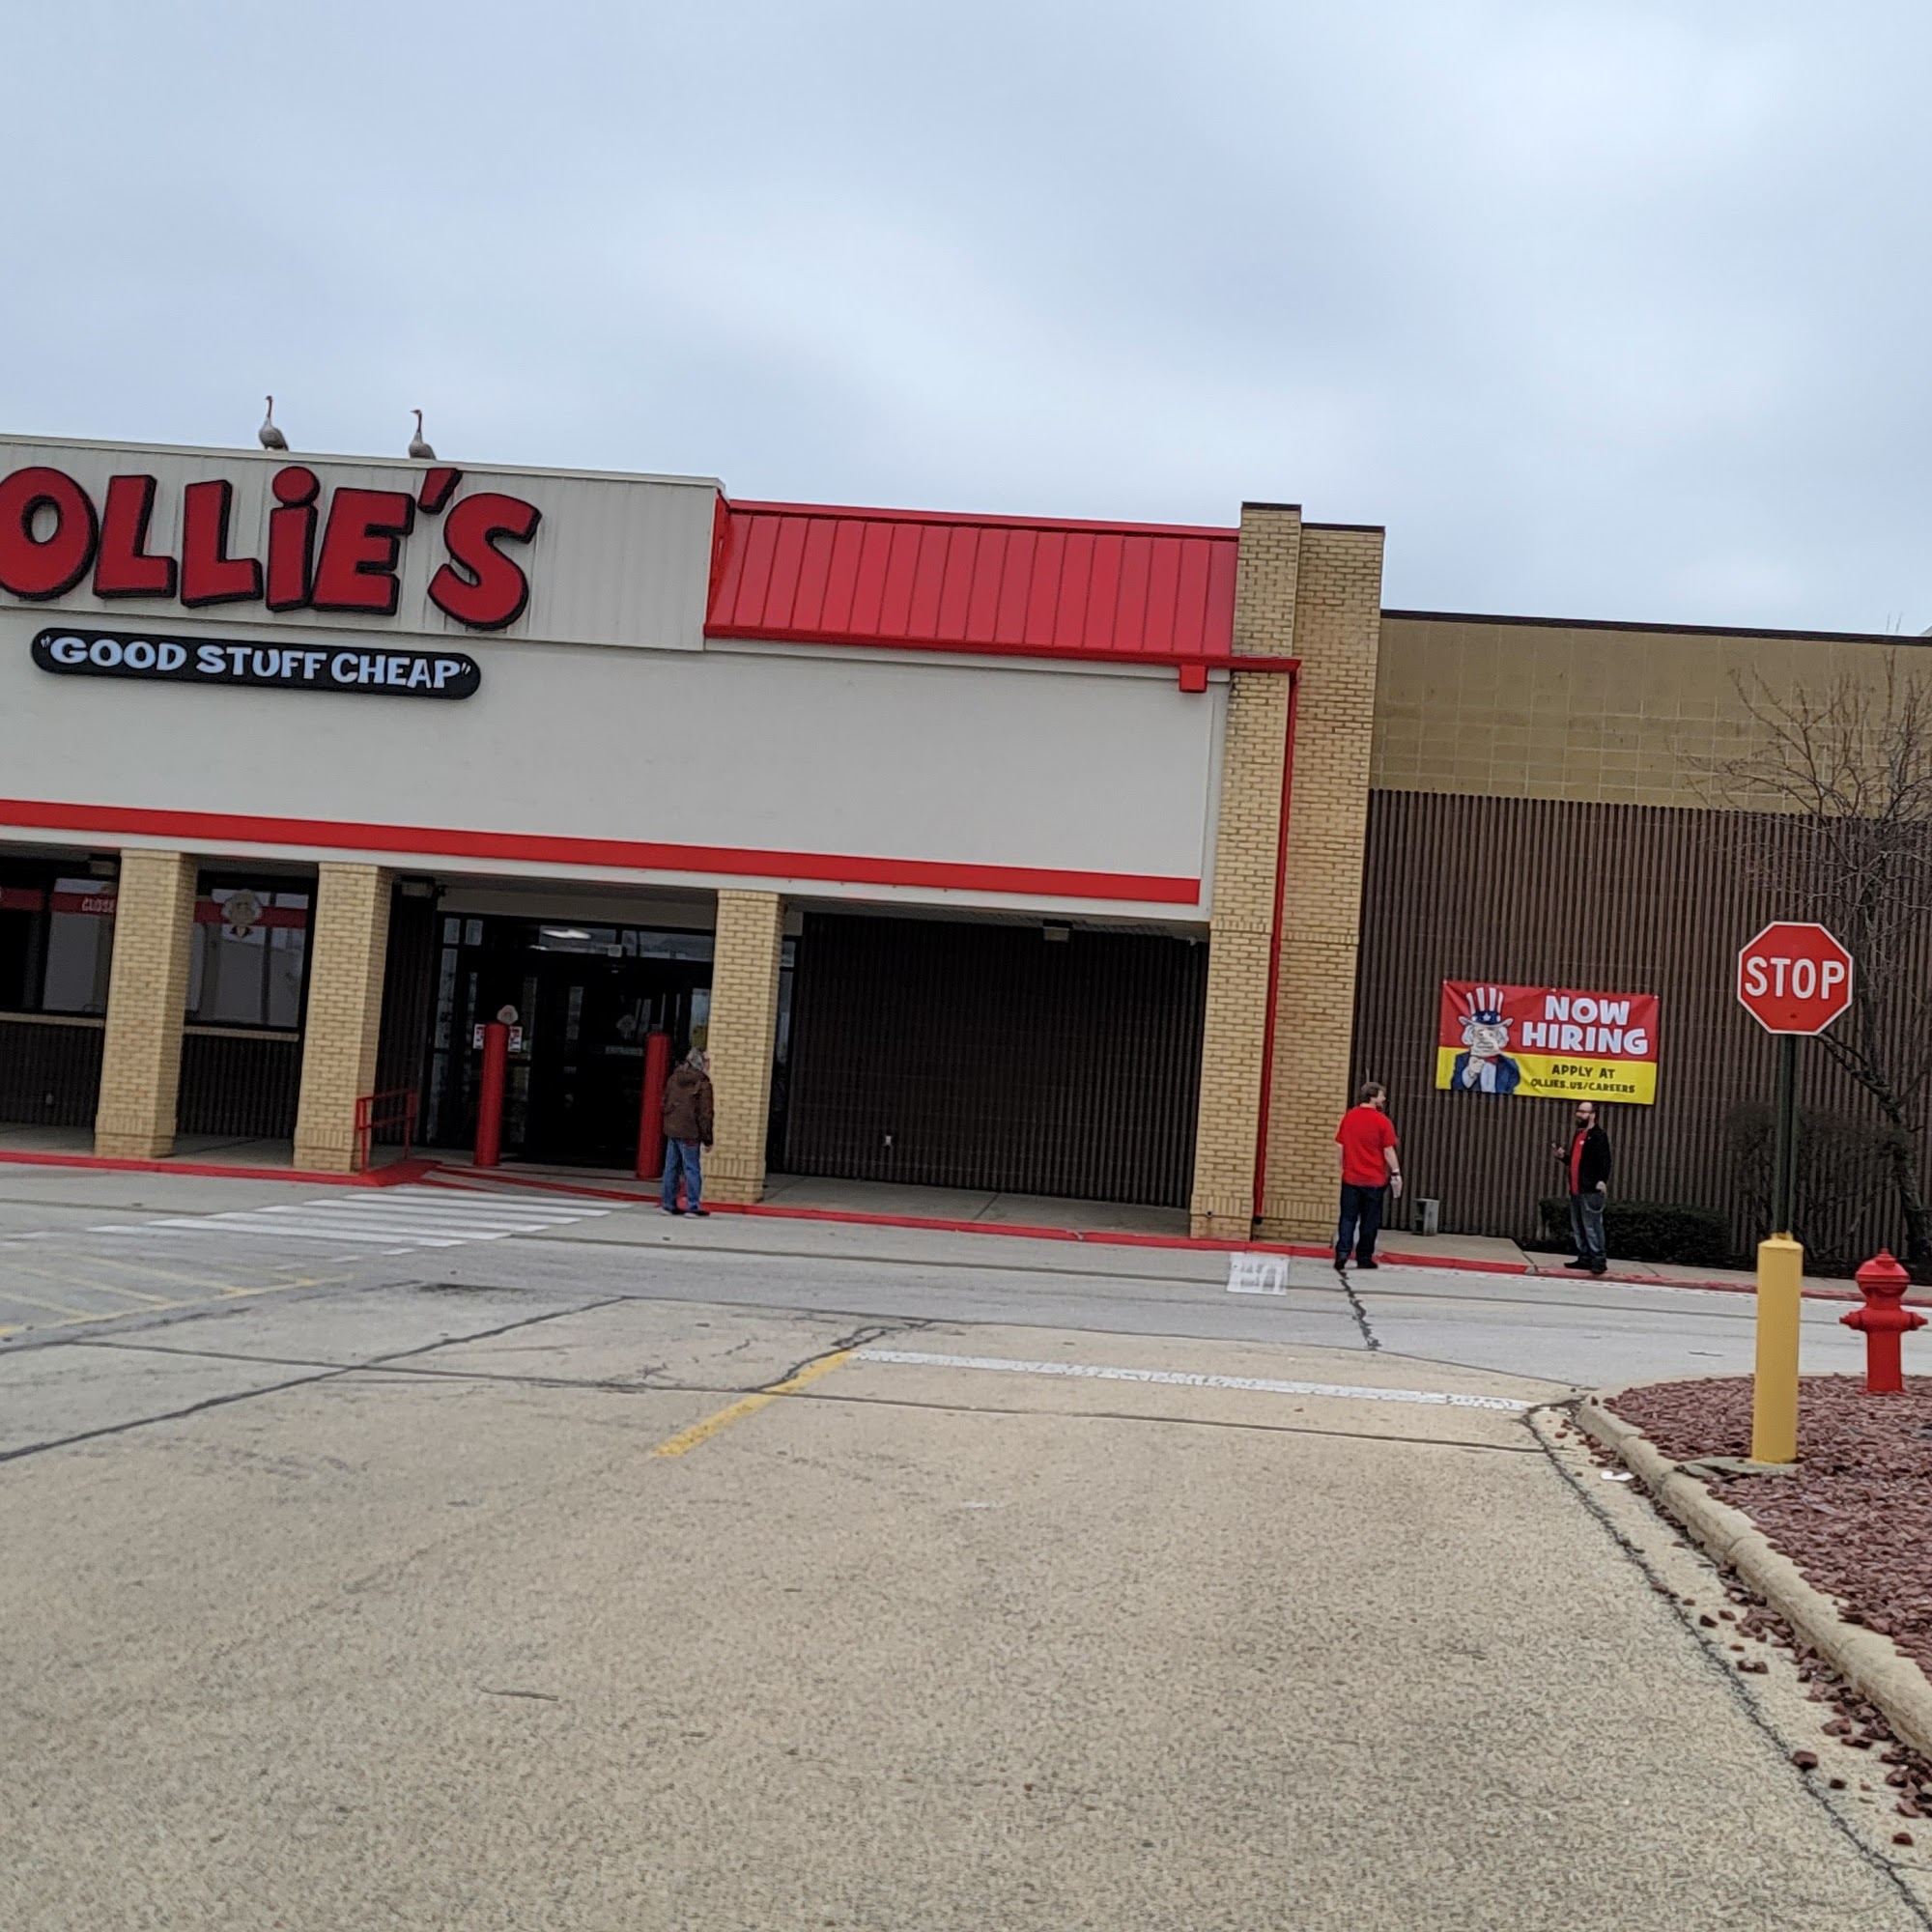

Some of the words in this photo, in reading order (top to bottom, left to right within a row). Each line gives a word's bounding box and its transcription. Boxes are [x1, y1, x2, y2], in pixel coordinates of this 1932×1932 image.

[196, 644, 327, 679] STUFF
[1745, 956, 1845, 1000] STOP
[1545, 995, 1630, 1026] NOW
[1521, 1021, 1648, 1055] HIRING
[1551, 1065, 1593, 1078] APPLY
[1599, 1067, 1616, 1079] AT
